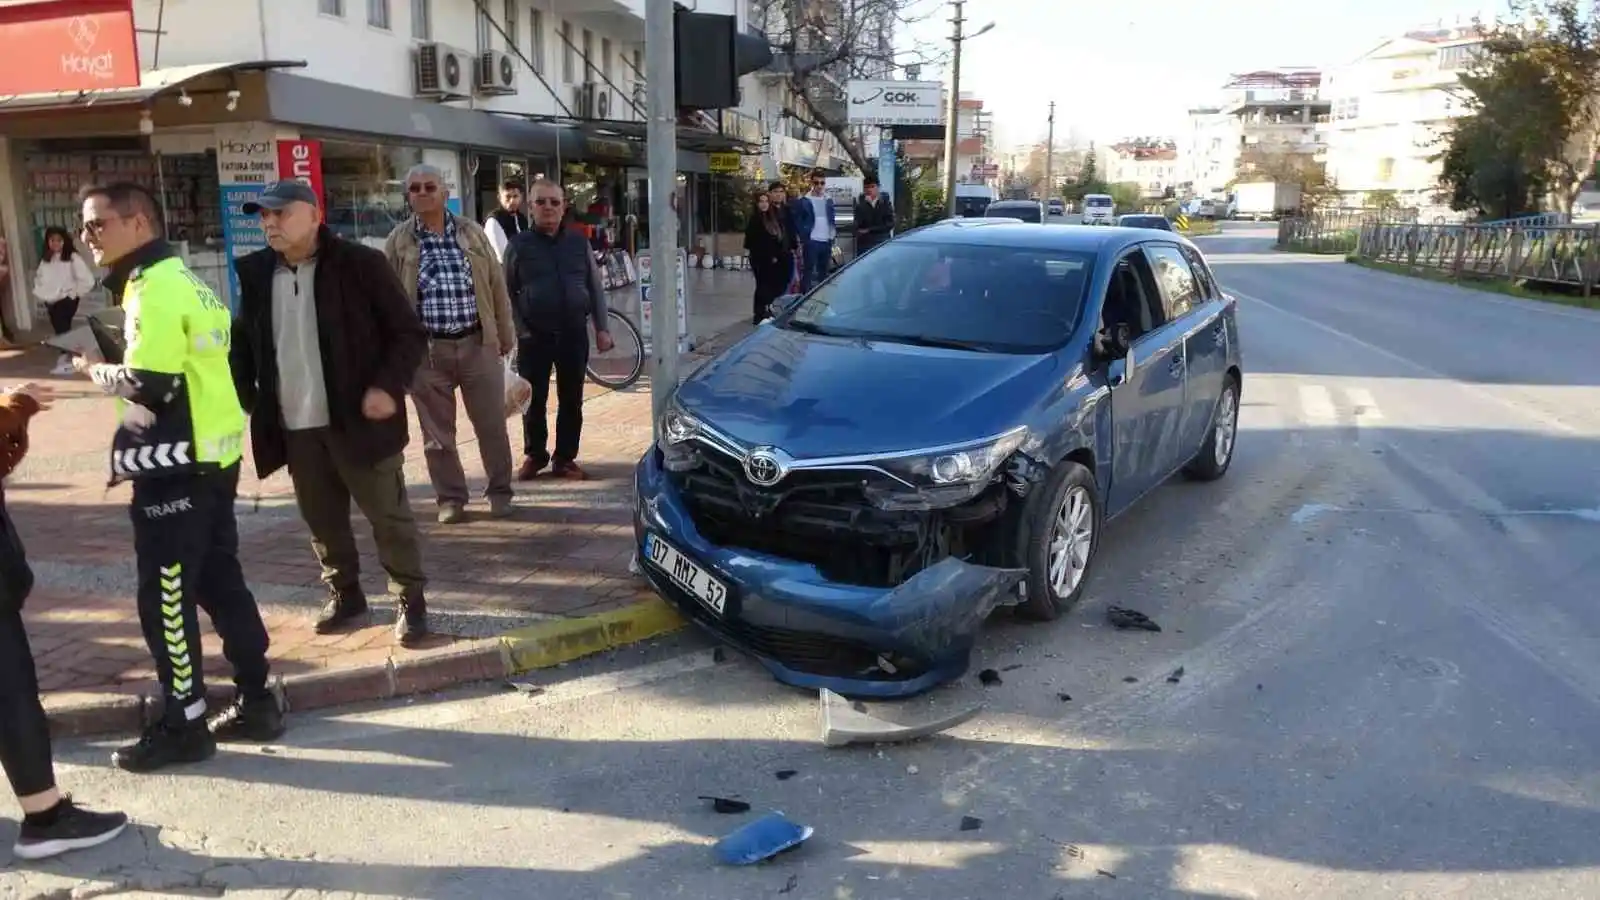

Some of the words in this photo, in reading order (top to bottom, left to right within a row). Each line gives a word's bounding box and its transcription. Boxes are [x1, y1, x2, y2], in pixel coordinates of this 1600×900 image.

[61, 50, 113, 76] Hayat
[220, 140, 271, 155] Hayat
[652, 539, 668, 564] 07
[706, 578, 724, 610] 52
